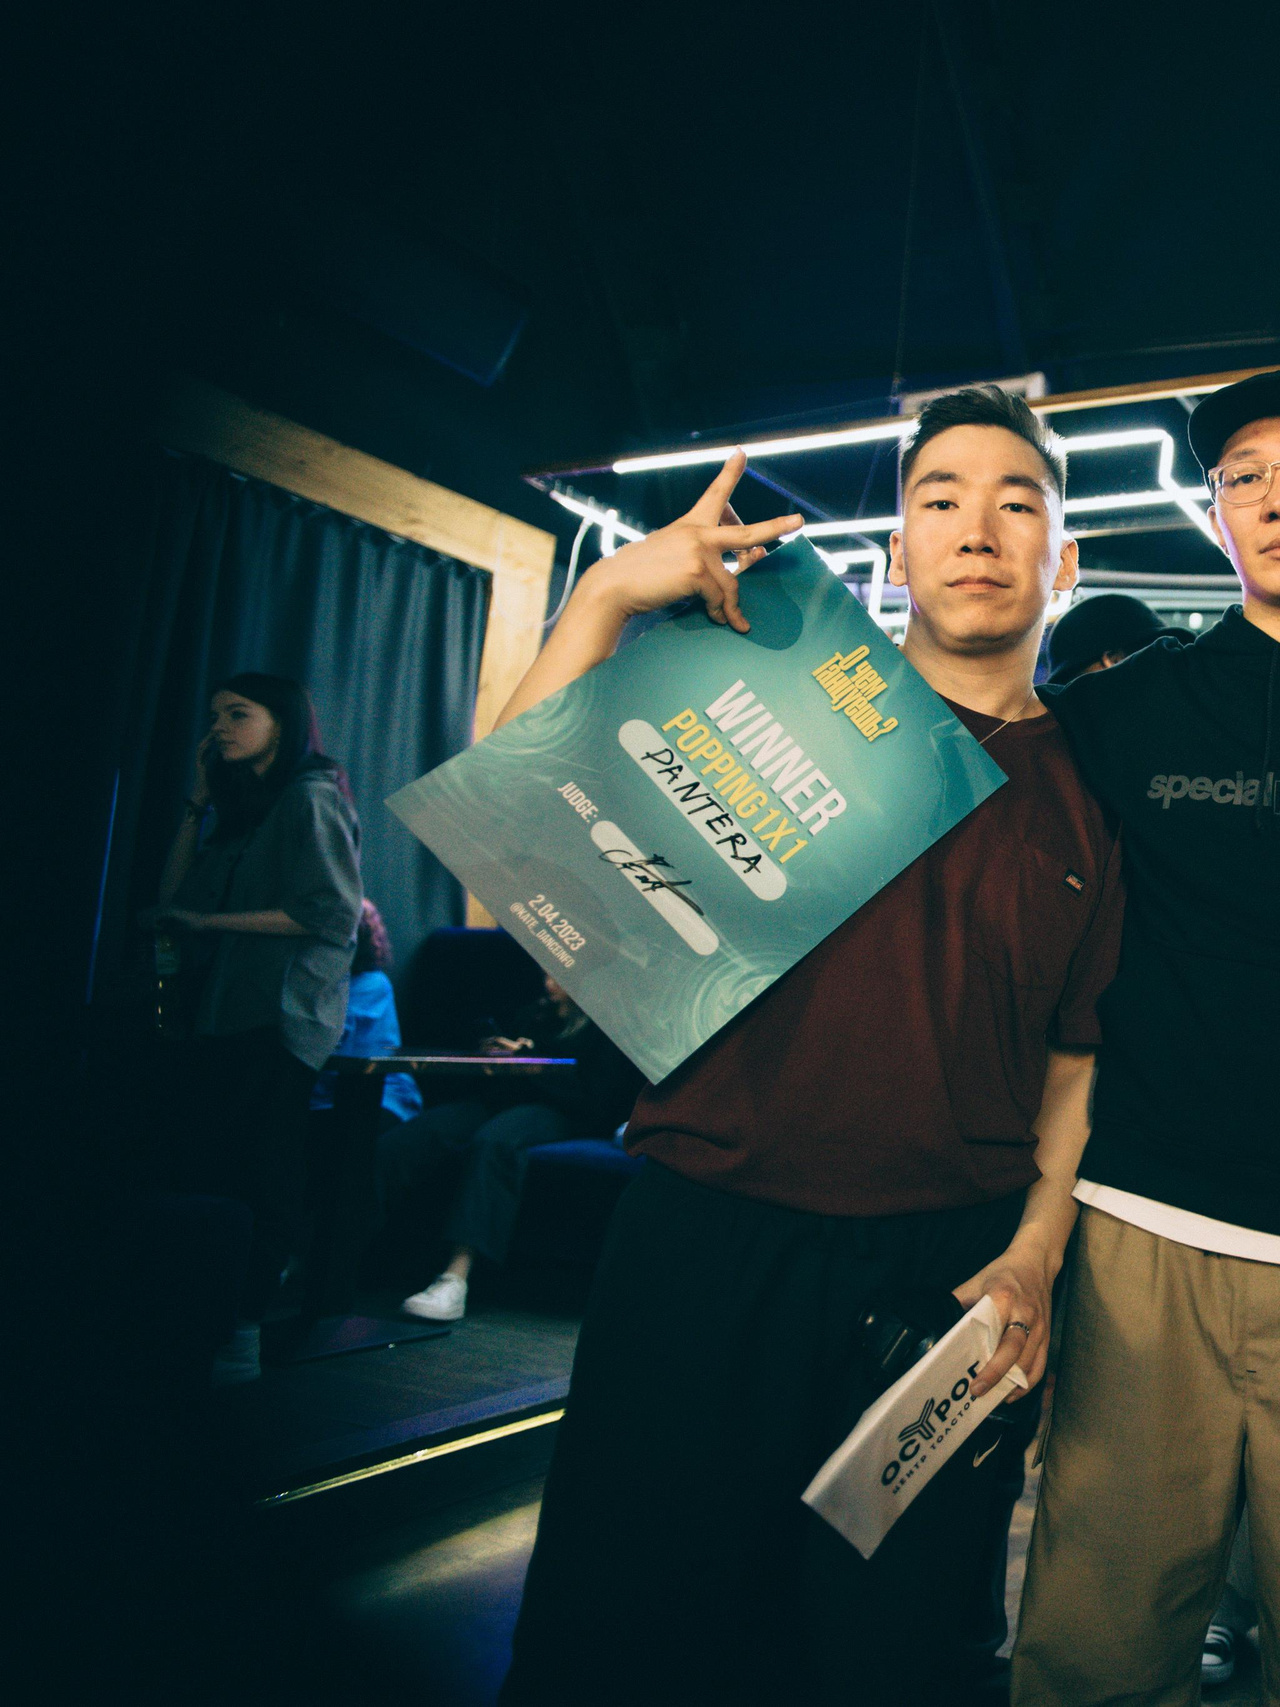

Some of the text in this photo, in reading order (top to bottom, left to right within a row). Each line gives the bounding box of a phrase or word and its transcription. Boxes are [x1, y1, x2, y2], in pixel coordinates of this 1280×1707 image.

[661, 707, 768, 819] POPPING
[704, 678, 847, 837] WINNER
[557, 781, 599, 824] JUDGE:
[640, 747, 763, 874] PANTERA
[1147, 770, 1275, 810] special
[508, 901, 577, 969] @KATE_DANCEINFO
[527, 893, 587, 952] 2.04.2023
[930, 1395, 978, 1450] ТОЛСТОВ
